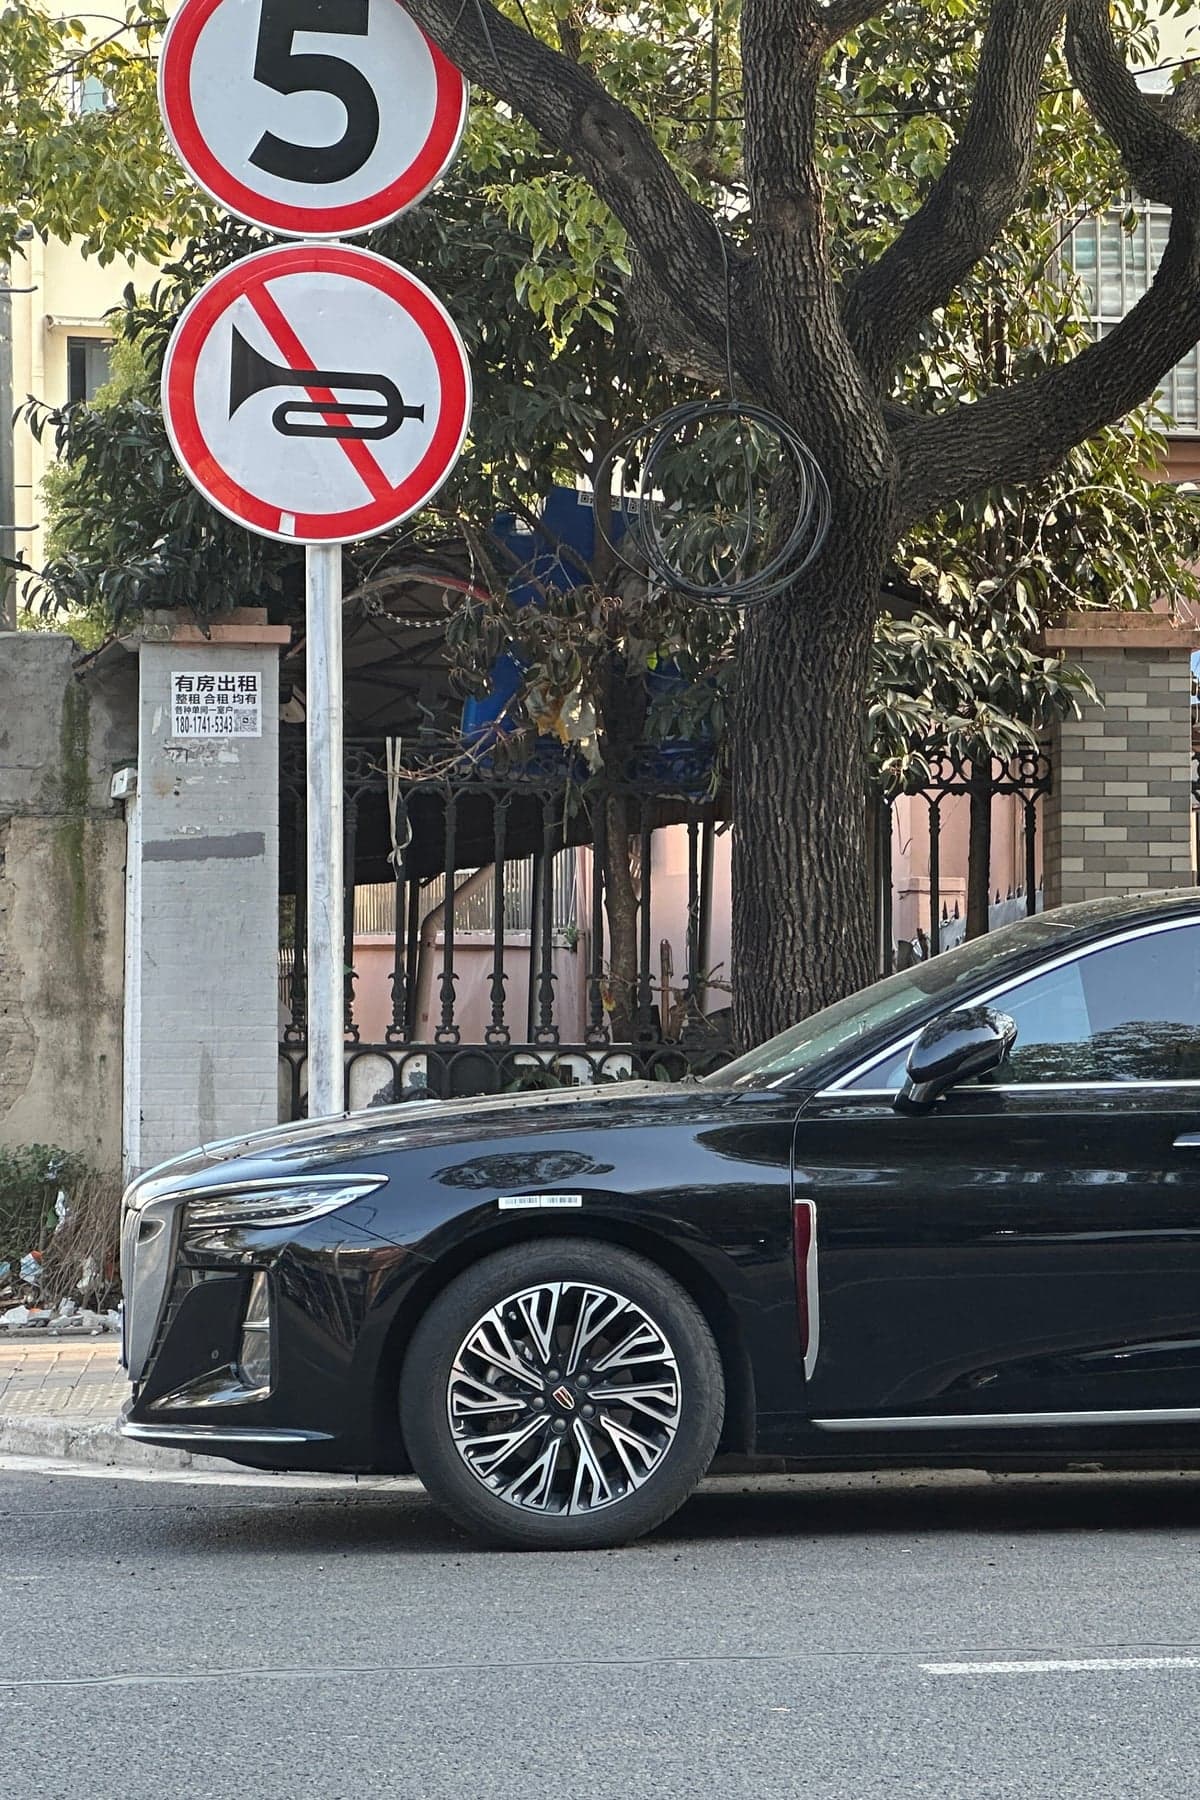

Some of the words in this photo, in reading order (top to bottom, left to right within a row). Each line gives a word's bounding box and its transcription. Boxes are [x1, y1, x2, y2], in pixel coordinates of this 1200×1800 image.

[249, 0, 379, 184] 5
[175, 675, 258, 692] 有房出租
[176, 694, 200, 704] 整租
[203, 693, 228, 704] 合租
[232, 694, 257, 704] 均有
